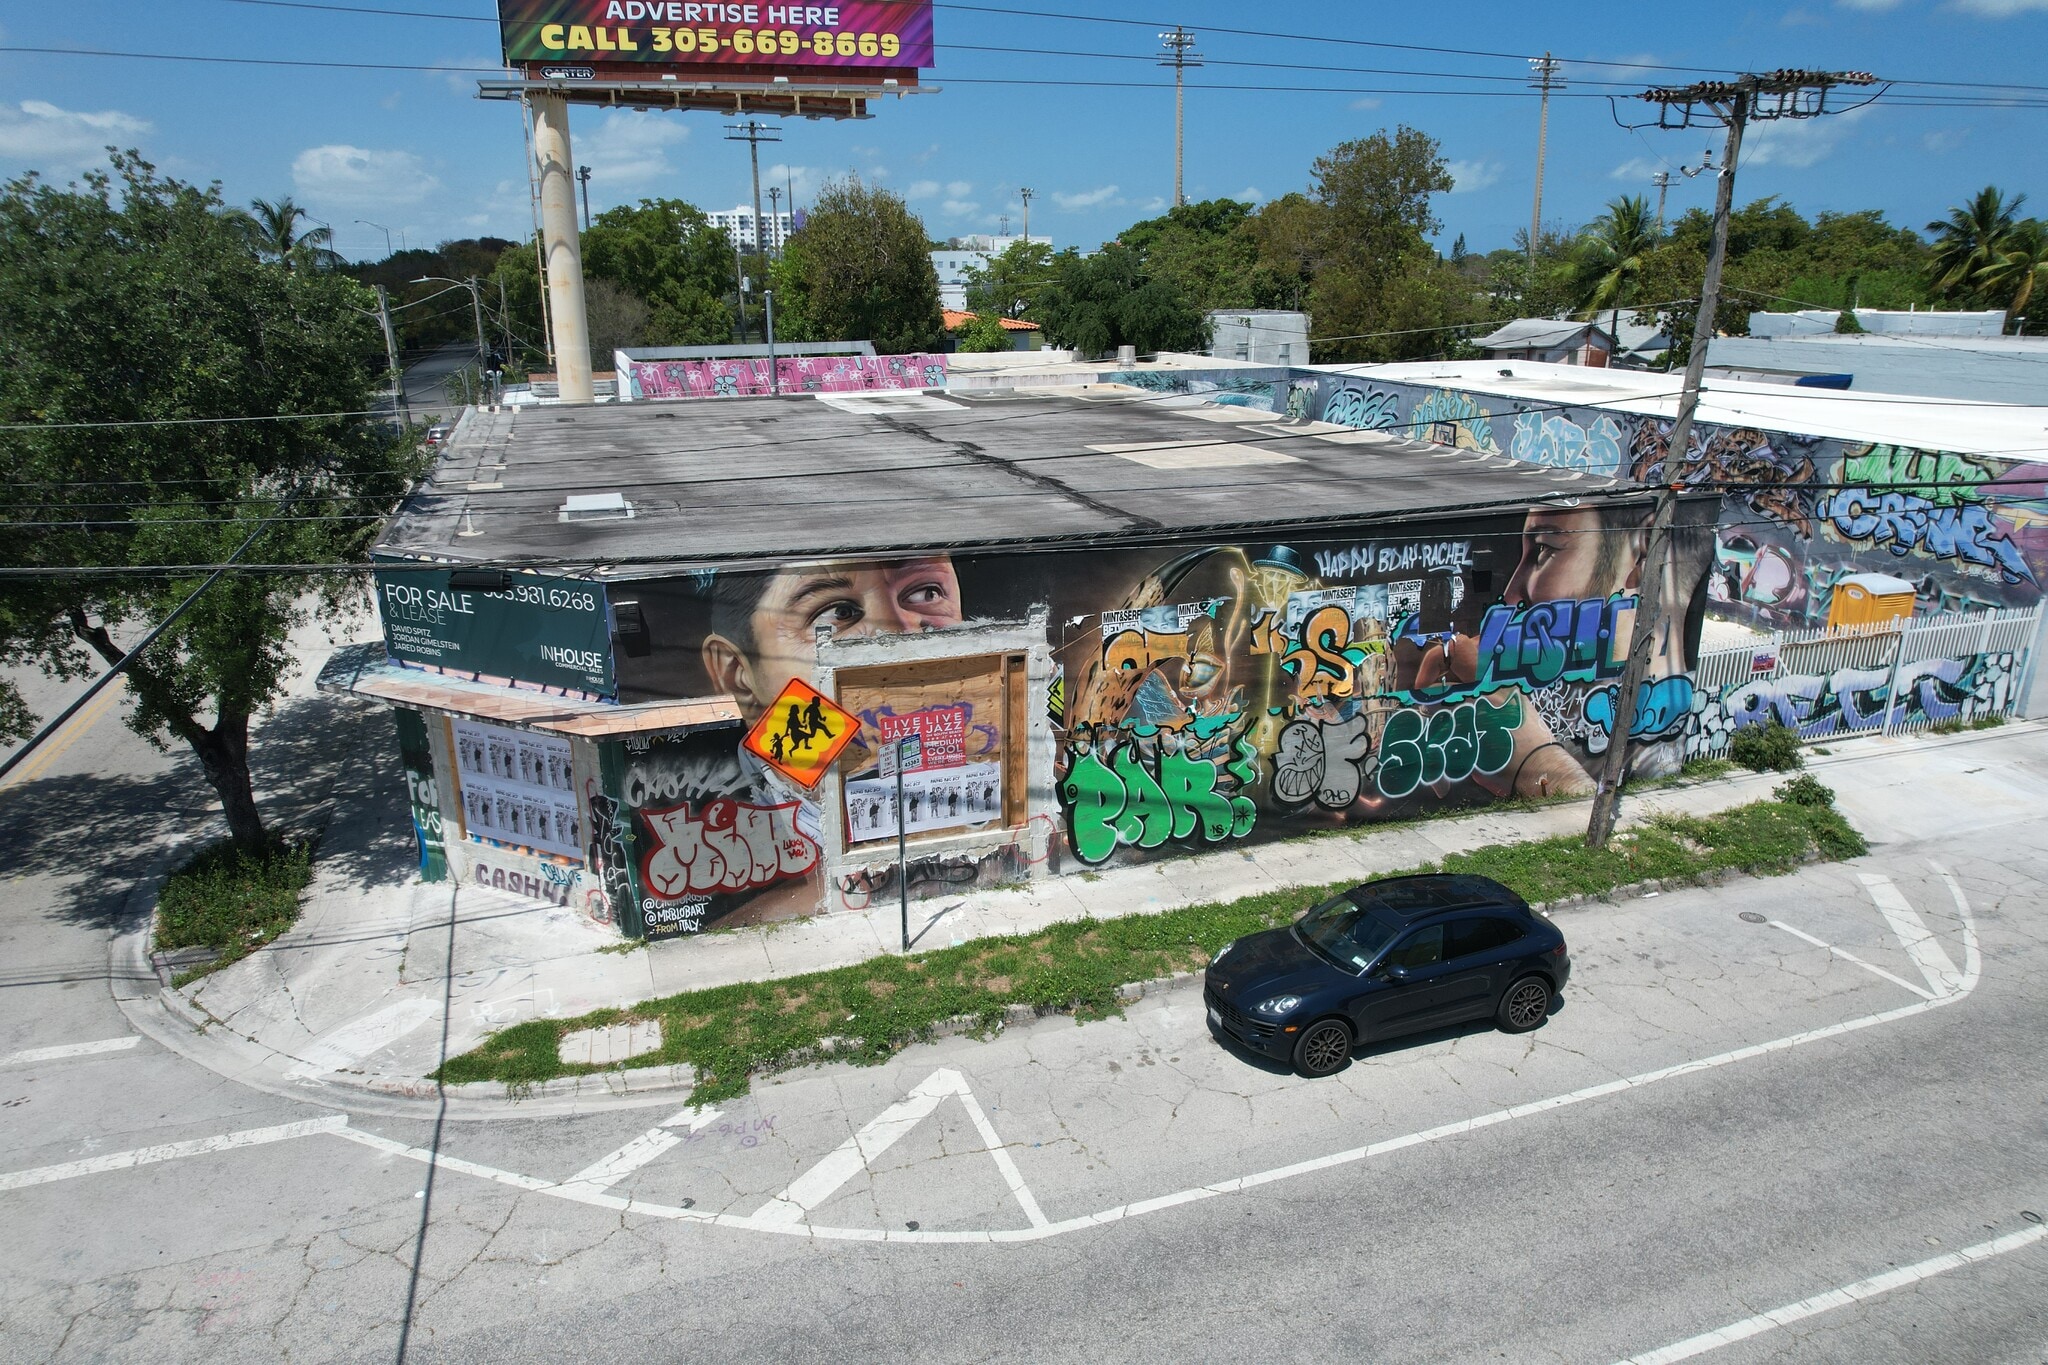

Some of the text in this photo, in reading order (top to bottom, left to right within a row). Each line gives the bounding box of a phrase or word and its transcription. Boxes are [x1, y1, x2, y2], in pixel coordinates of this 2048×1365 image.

[606, 0, 839, 26] ADVERTISE HERE
[540, 23, 901, 58] CALL 305-669-8669
[1314, 543, 1376, 578] HAPPY
[1422, 540, 1473, 568] RACHEL
[1321, 587, 1355, 601] MINT&SERF
[1388, 581, 1422, 595] MINT&SERF
[385, 583, 475, 614] FOR SALE
[389, 602, 447, 625] & LEASE
[391, 623, 432, 638] DAVID SPITZ
[392, 632, 461, 650] JORDAN GIMELSTEIN
[394, 642, 442, 657] JARED ROBINS
[540, 644, 603, 669] INHOUSE
[554, 661, 604, 675] COMMERCIAL SALES
[884, 716, 921, 730] LIVE
[925, 712, 962, 725] LIVE
[884, 725, 921, 739] JAZZ
[926, 721, 963, 734] JAZZ
[926, 744, 963, 757] COOL
[644, 902, 709, 926] @MRBLOBART
[654, 922, 679, 935] FROM
